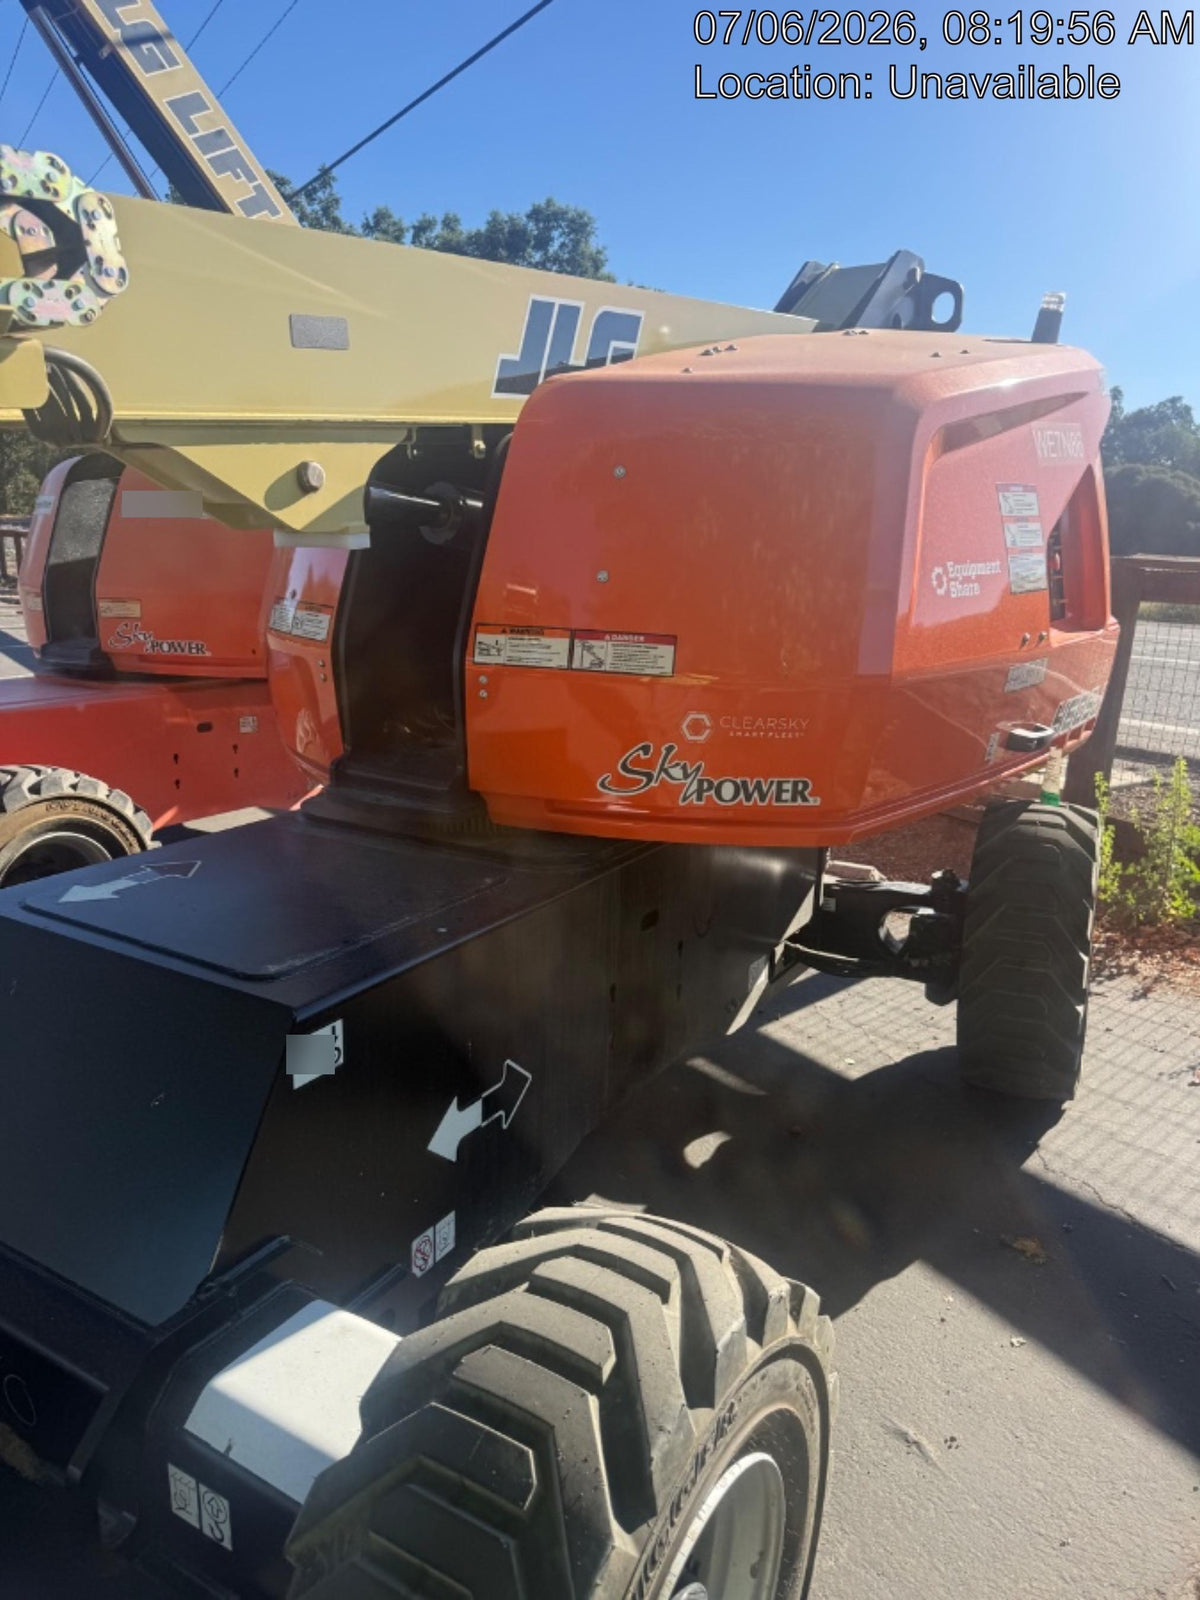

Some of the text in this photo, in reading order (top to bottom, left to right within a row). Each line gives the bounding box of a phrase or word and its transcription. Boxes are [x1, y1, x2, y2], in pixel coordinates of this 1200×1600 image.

[163, 89, 284, 220] LIFT
[490, 293, 646, 398] JLG
[945, 559, 1002, 580] Equipment
[949, 580, 981, 598] Share
[611, 633, 645, 642] DANGER
[149, 639, 209, 656] POWER
[719, 715, 811, 731] CLEARSKY
[767, 731, 800, 739] FLEET
[696, 776, 816, 806] POWER
